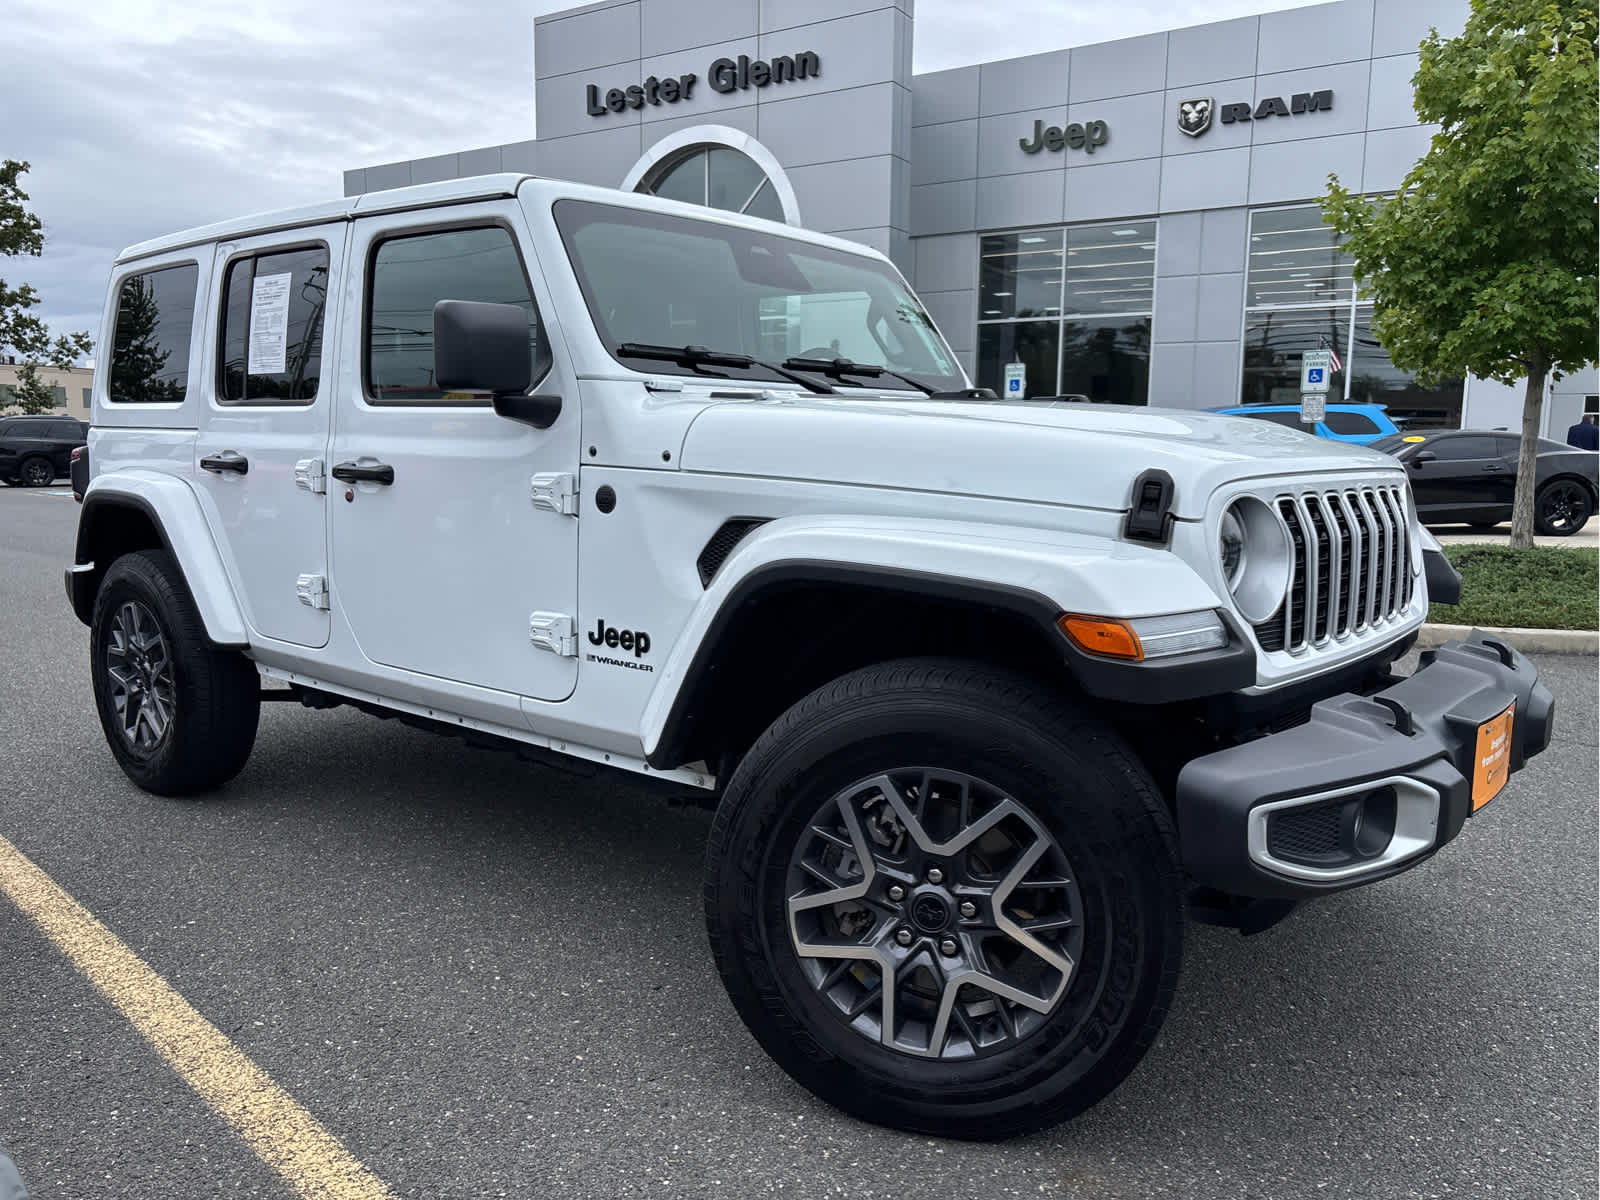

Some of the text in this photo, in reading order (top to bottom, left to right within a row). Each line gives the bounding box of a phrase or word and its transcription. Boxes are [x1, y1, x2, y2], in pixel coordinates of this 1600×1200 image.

[586, 51, 819, 116] Lester Glenn
[1220, 89, 1334, 124] RAM
[1019, 119, 1109, 154] Jeep
[588, 619, 650, 657] Jeep
[596, 656, 653, 672] WRANGLER
